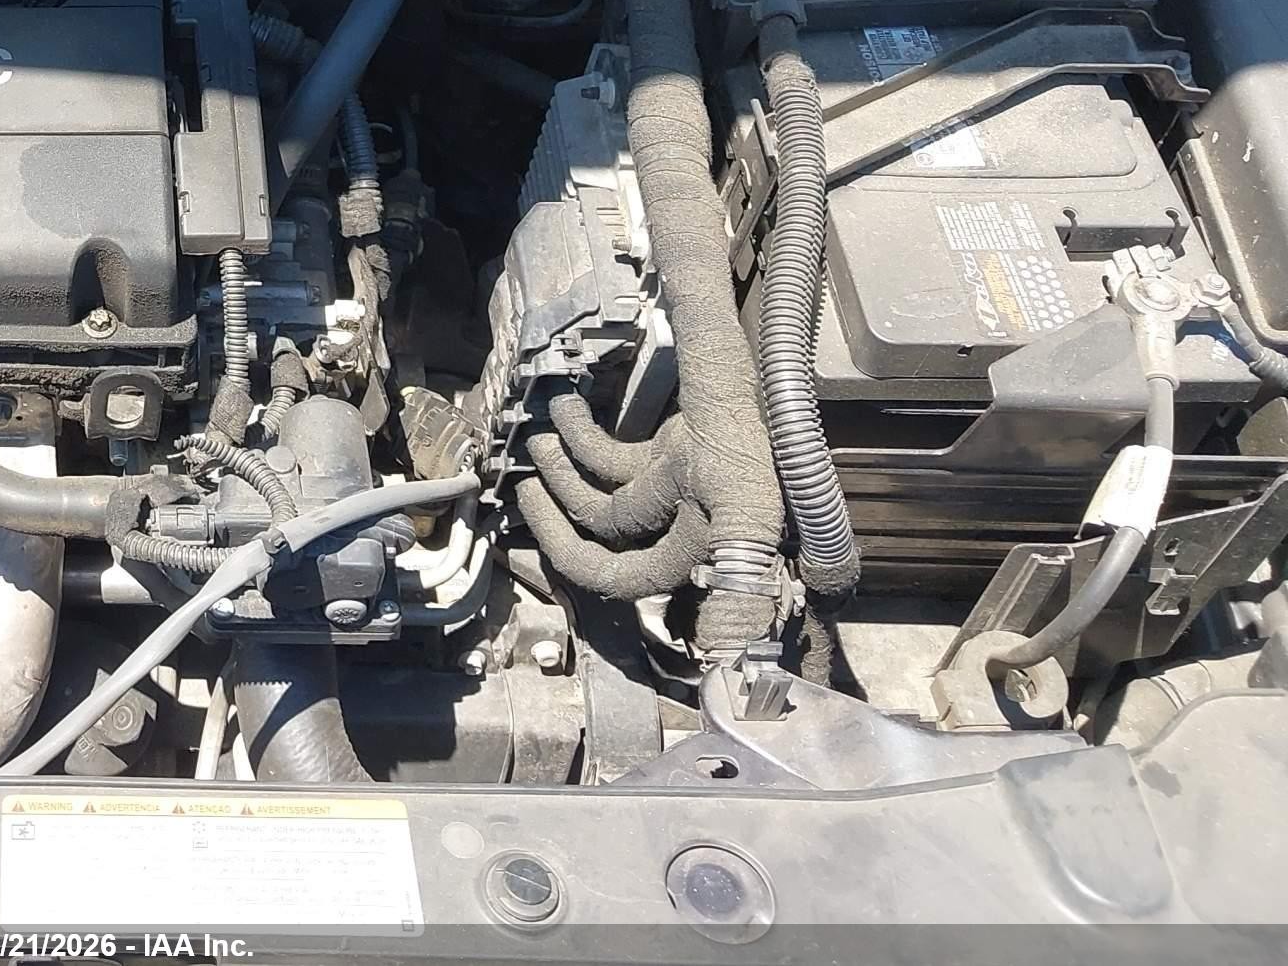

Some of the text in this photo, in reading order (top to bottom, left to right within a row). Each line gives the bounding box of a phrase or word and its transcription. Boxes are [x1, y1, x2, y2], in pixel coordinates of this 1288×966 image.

[28, 801, 73, 812] WARNING
[100, 803, 161, 813] ADVERTENCIA
[257, 804, 332, 816] AVERTISSEMENT
